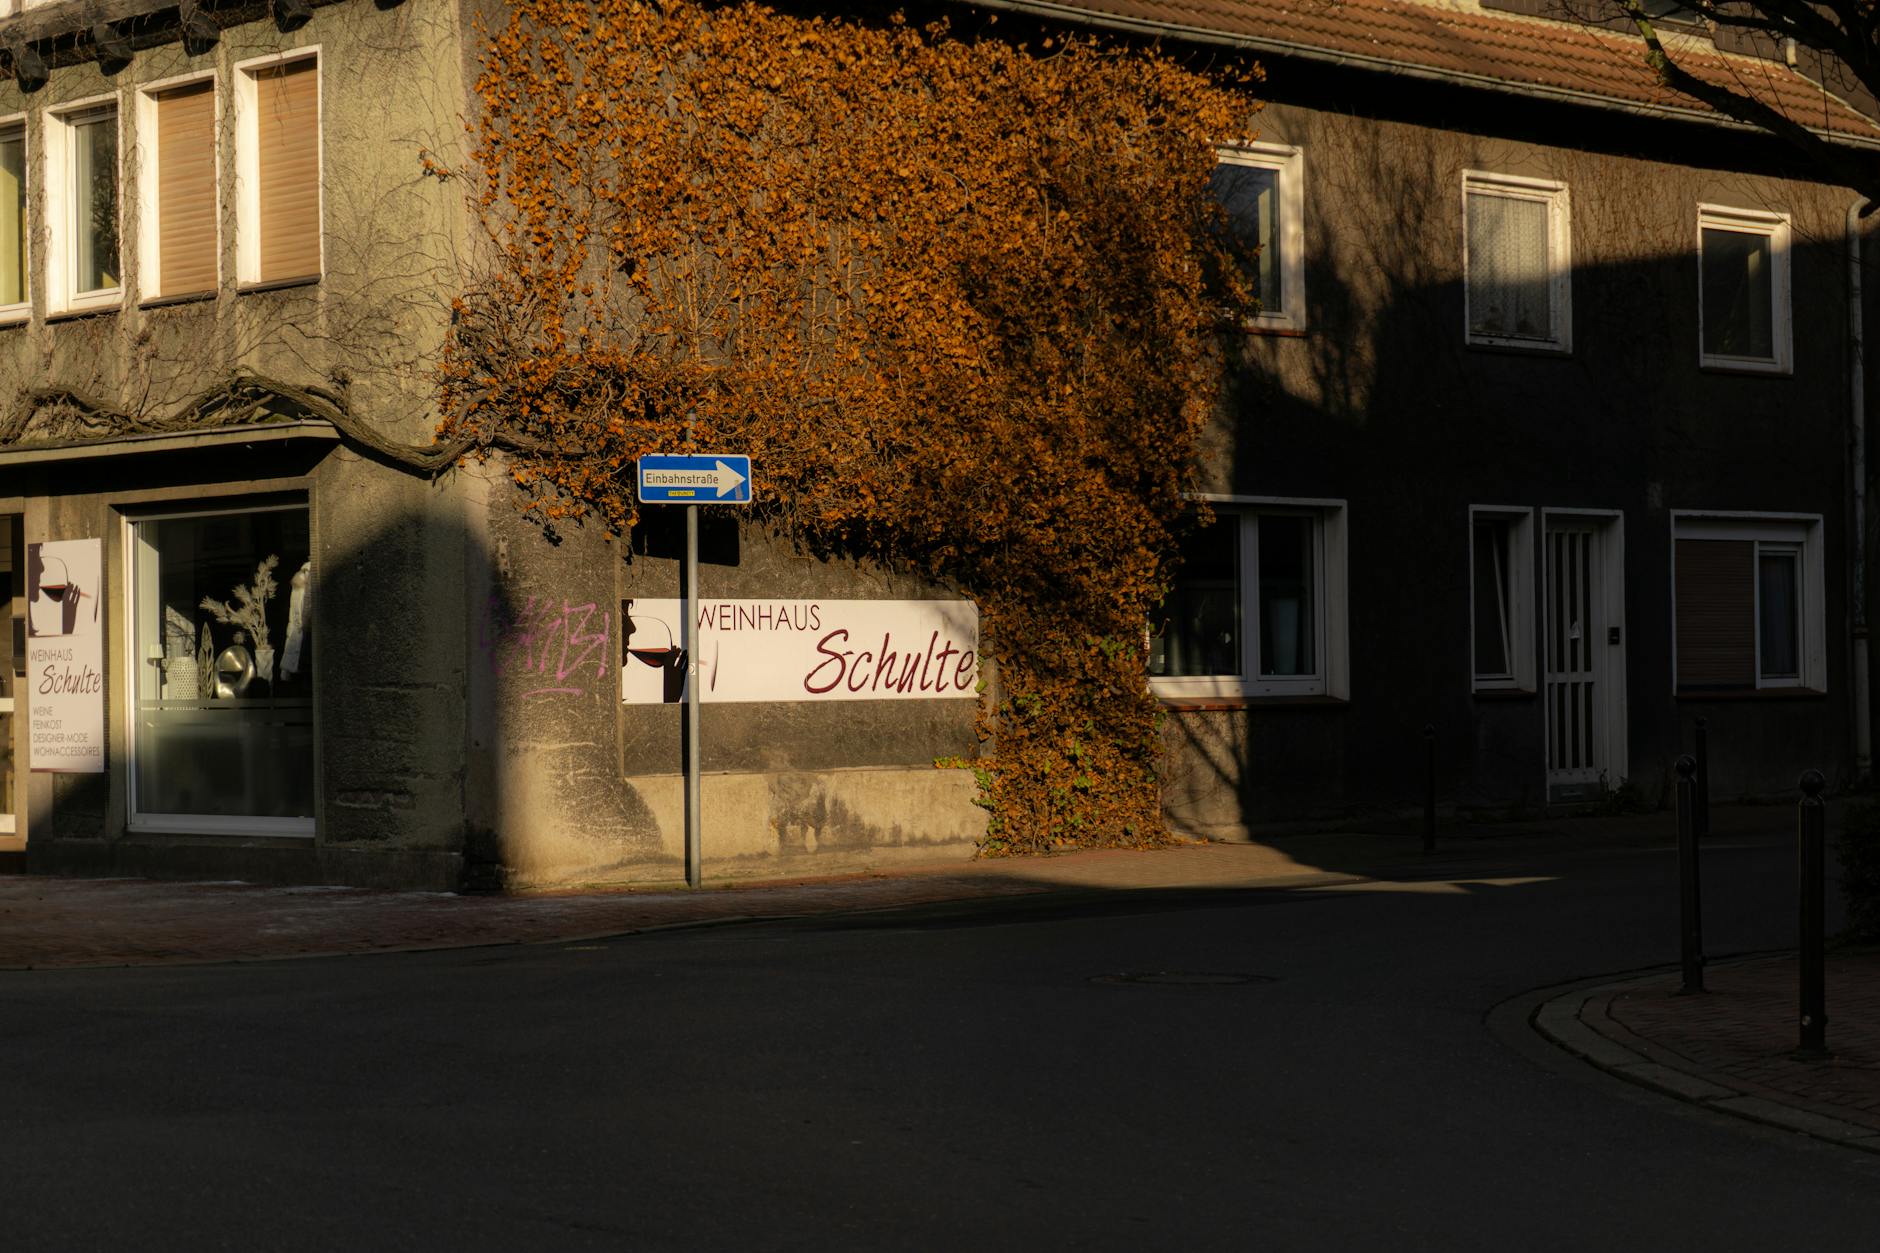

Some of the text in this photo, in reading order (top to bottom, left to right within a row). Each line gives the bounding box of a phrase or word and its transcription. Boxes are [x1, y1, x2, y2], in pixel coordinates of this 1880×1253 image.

[646, 473, 719, 484] Einbahnstraße
[698, 604, 821, 631] WEINHAUS
[31, 648, 72, 661] WEINHAUS
[803, 629, 975, 694] Schulte
[39, 664, 101, 694] Schulte
[33, 706, 53, 716] WEINE
[33, 719, 62, 729] FEINKOST
[34, 746, 100, 757] WOHNACCESSOIRES
